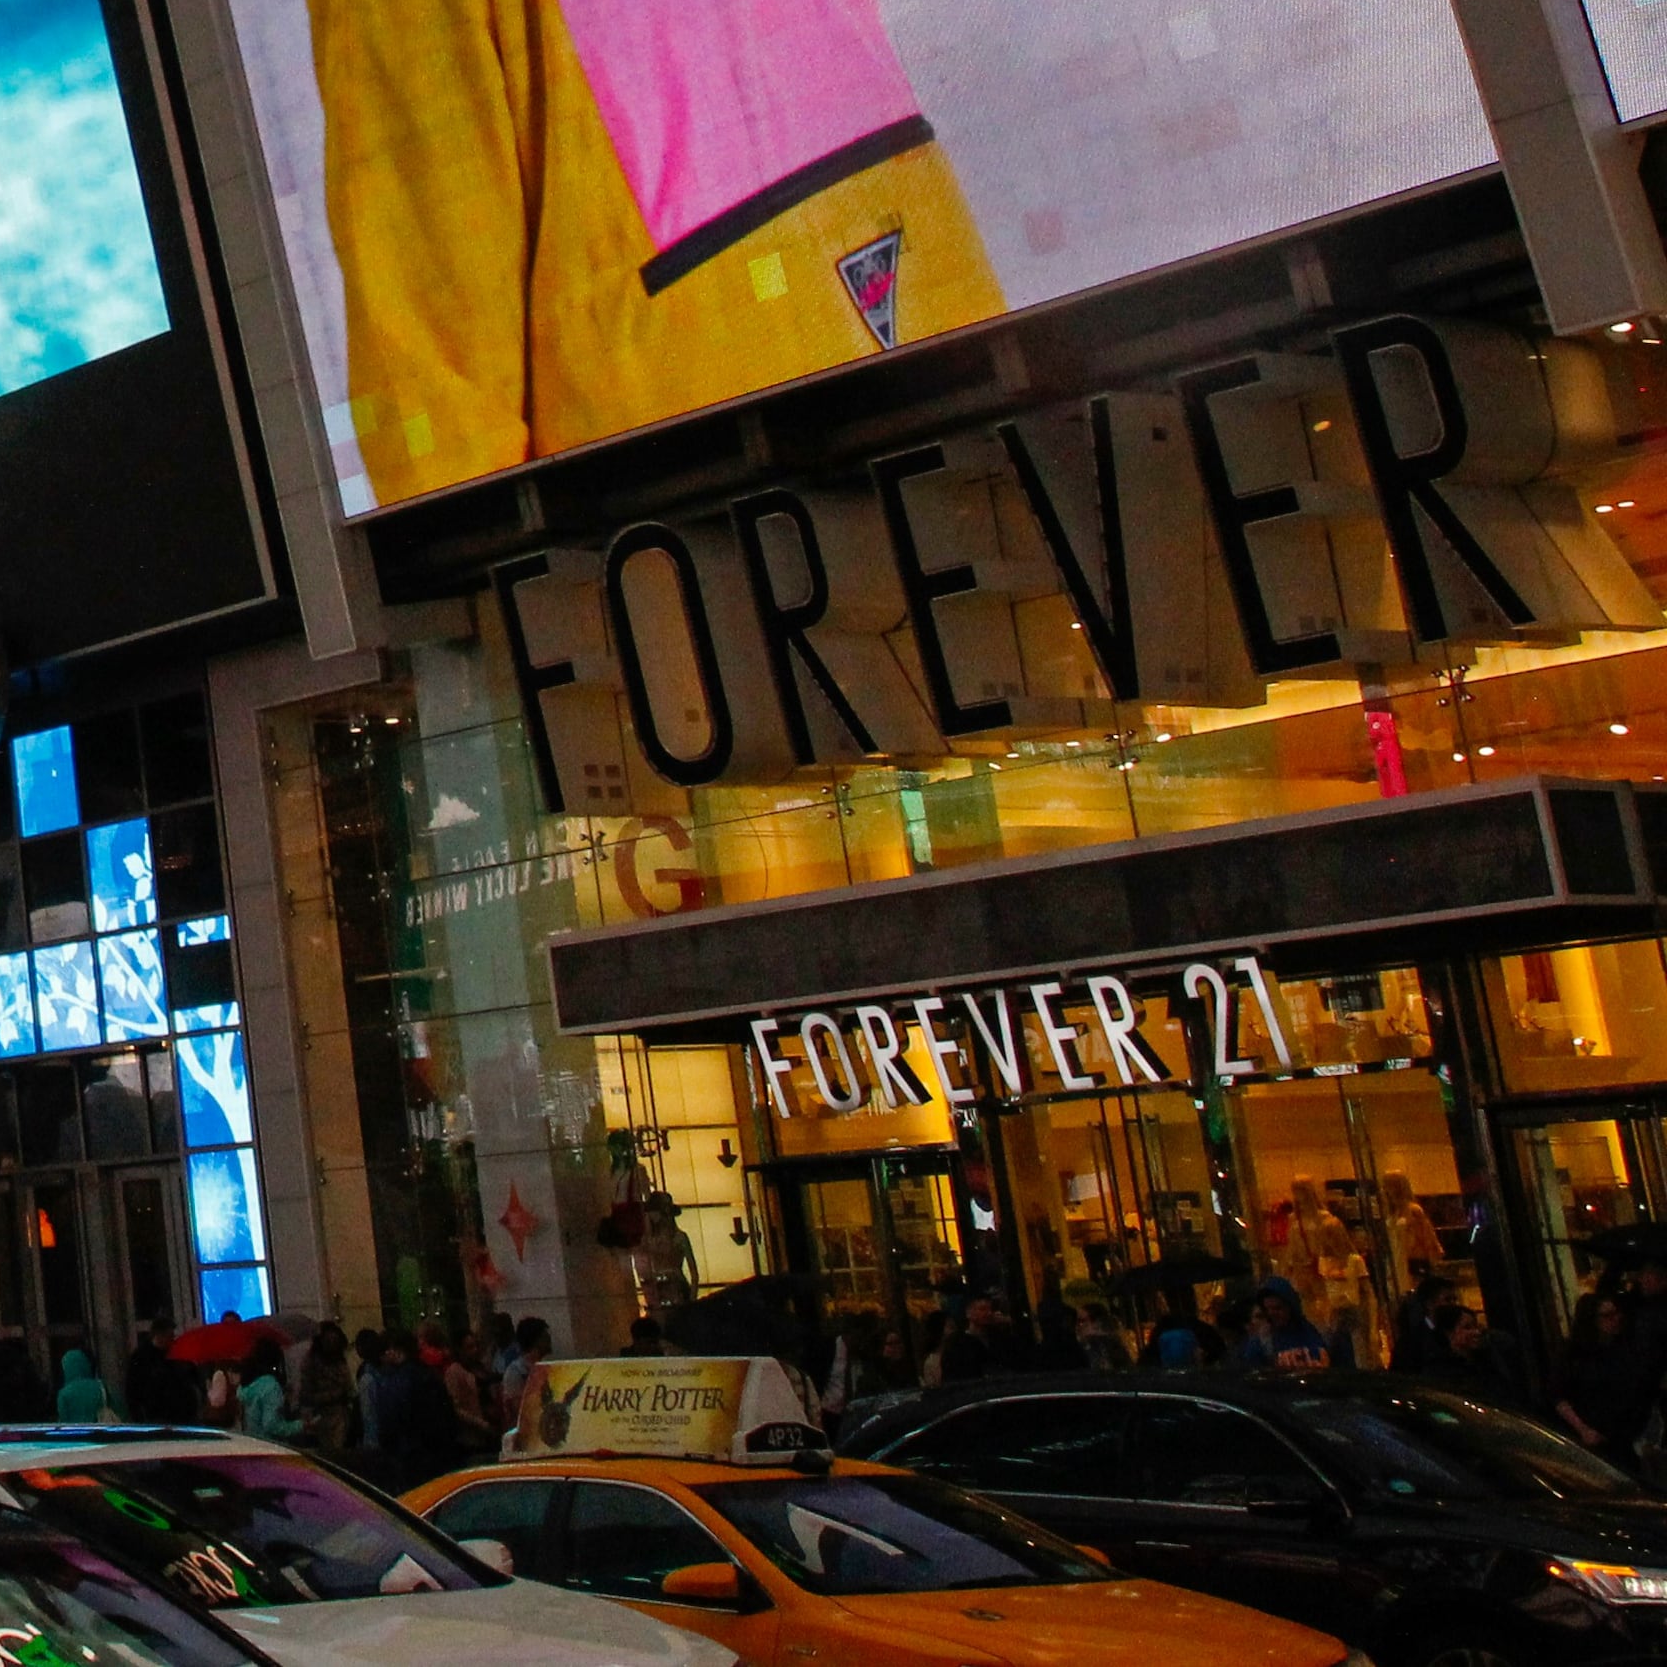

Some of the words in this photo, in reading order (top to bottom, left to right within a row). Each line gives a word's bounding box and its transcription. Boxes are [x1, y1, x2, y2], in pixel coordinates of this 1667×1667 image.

[491, 312, 1538, 814] FOREVER
[749, 974, 1162, 1119] FOREVER
[1182, 956, 1294, 1077] 21
[582, 1385, 650, 1413] HARRY
[651, 1384, 727, 1414] POTTER
